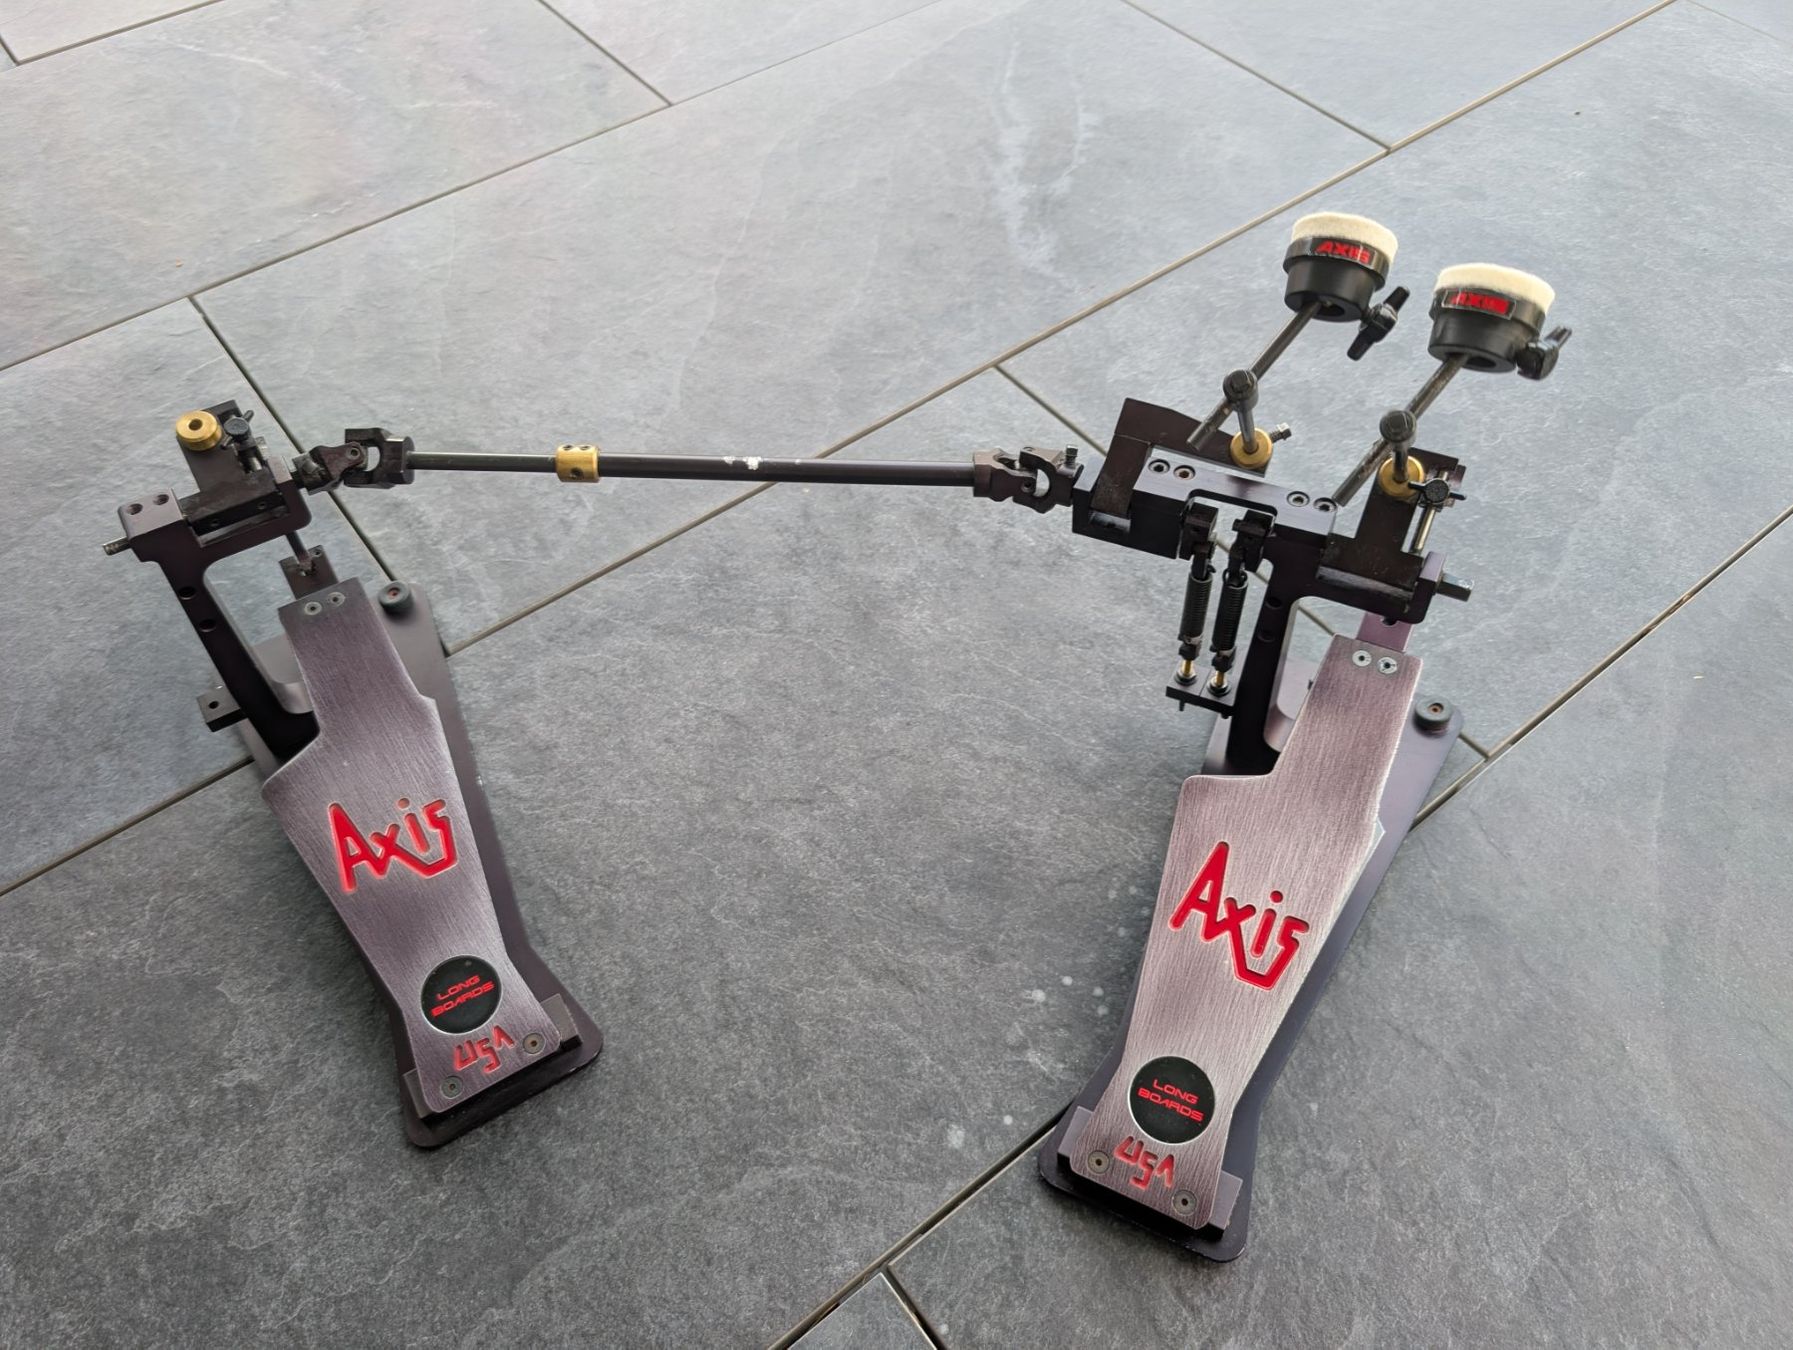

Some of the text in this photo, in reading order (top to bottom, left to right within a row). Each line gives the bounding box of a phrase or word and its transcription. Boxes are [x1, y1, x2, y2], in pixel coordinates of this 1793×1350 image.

[1315, 240, 1371, 264] AXIS
[328, 798, 458, 892] Axis
[1168, 841, 1310, 991] Axis
[431, 981, 495, 1017] BOARDS
[437, 975, 481, 1000] LONG
[454, 1025, 515, 1073] USA
[1138, 1087, 1204, 1122] BOARDS
[1152, 1078, 1199, 1105] LONG
[1114, 1136, 1175, 1189] USA
